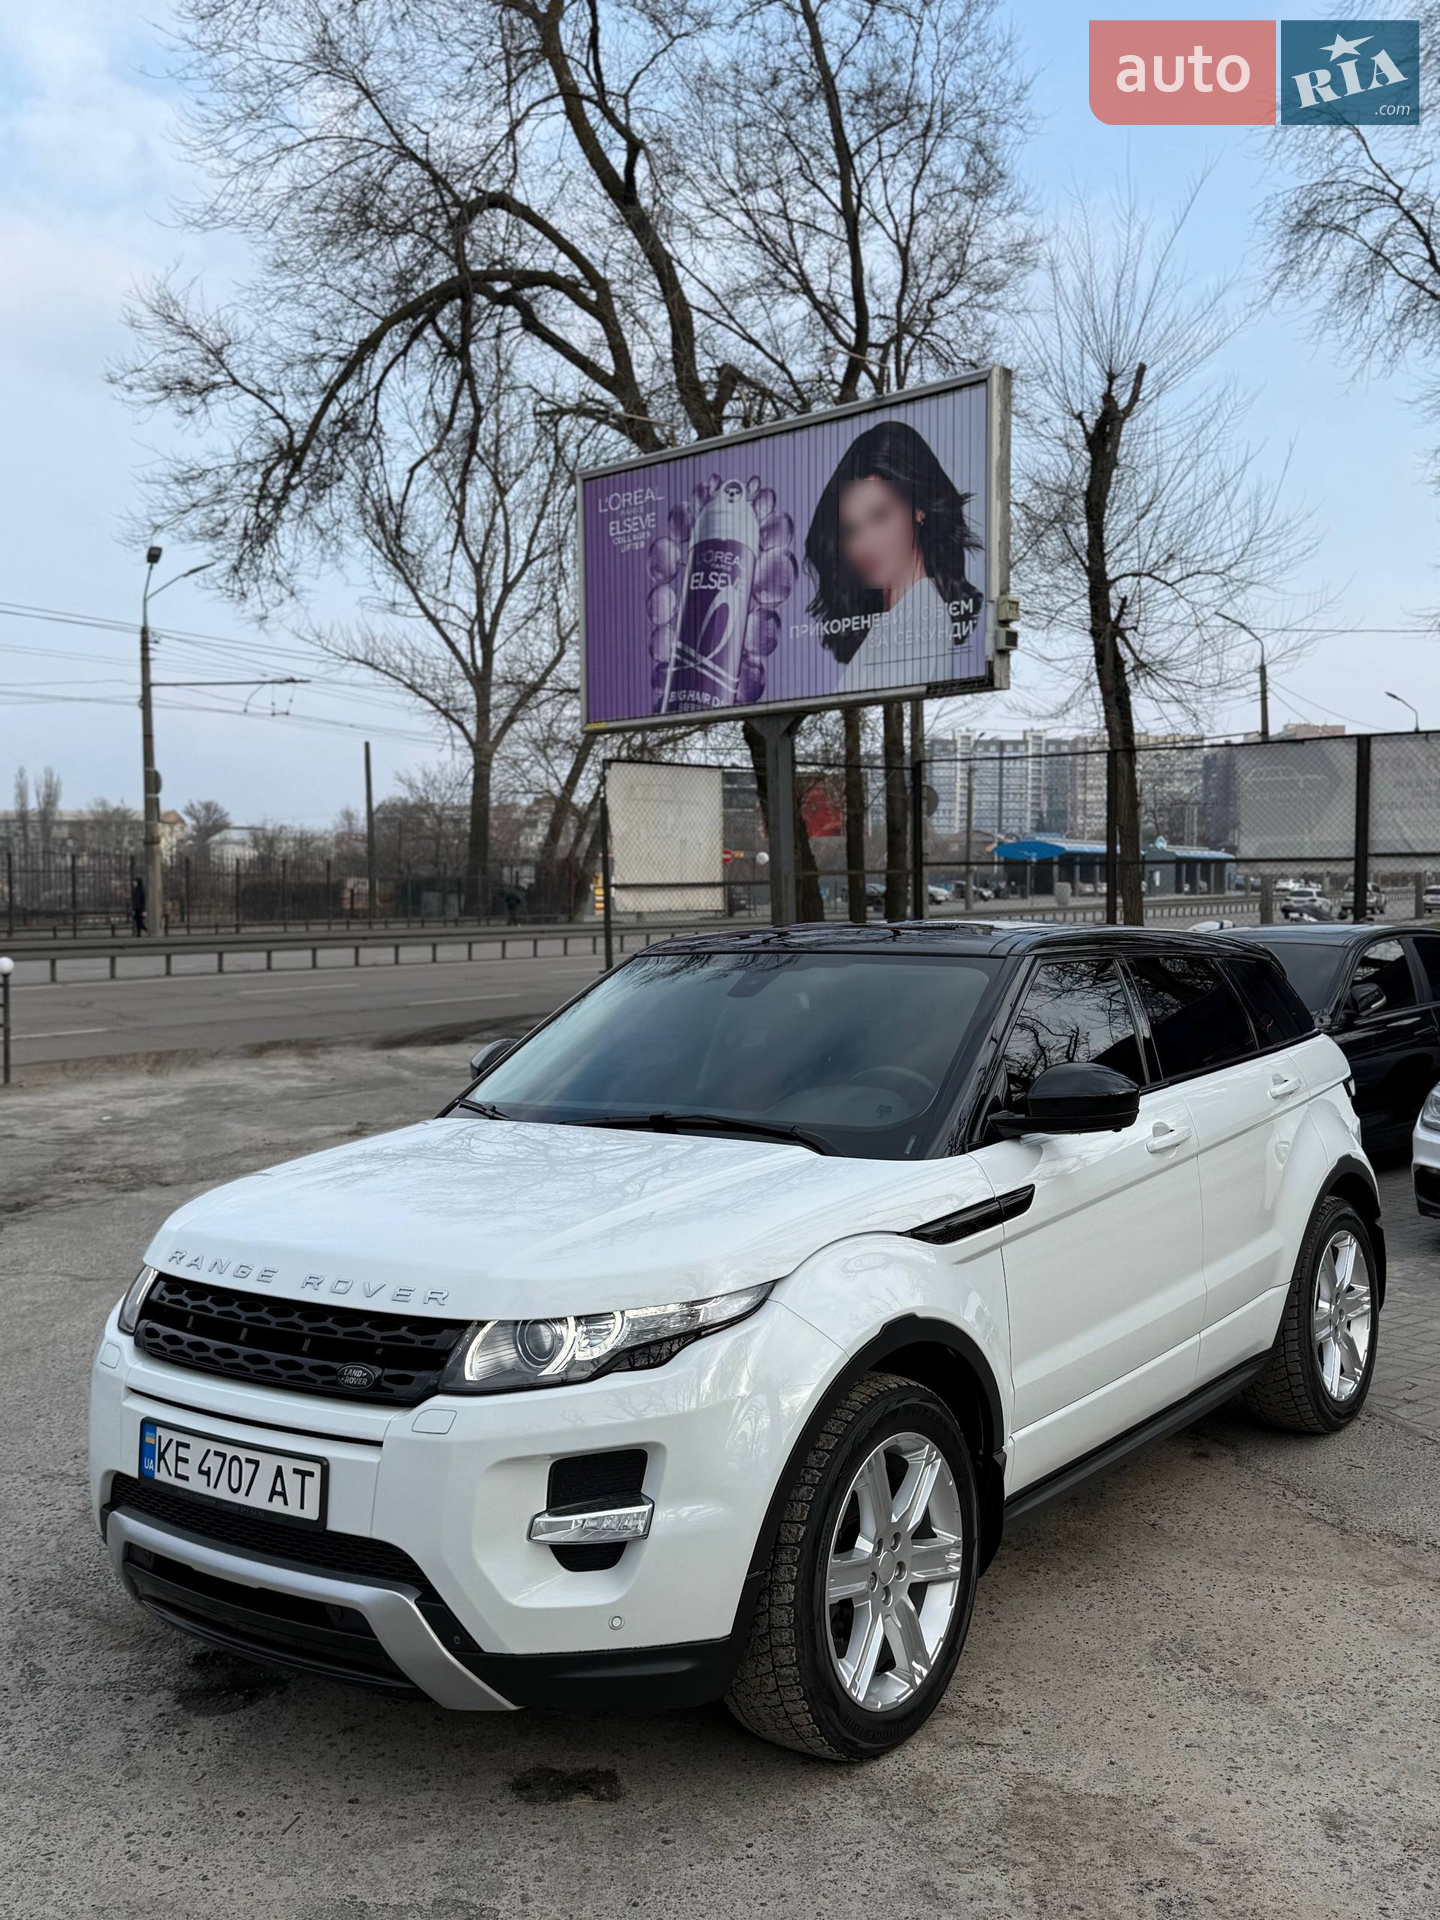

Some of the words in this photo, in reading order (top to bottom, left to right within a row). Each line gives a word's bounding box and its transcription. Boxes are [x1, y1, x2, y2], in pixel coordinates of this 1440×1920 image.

[608, 512, 657, 537] ELSEVE
[690, 571, 744, 591] ELSEV
[168, 1250, 279, 1284] RANGE
[301, 1273, 450, 1306] ROVER
[343, 1368, 363, 1378] LAND
[343, 1376, 368, 1386] ROVER
[144, 1457, 155, 1471] UA
[157, 1434, 191, 1482] KE
[198, 1449, 260, 1497] 4707
[268, 1465, 315, 1510] AT
